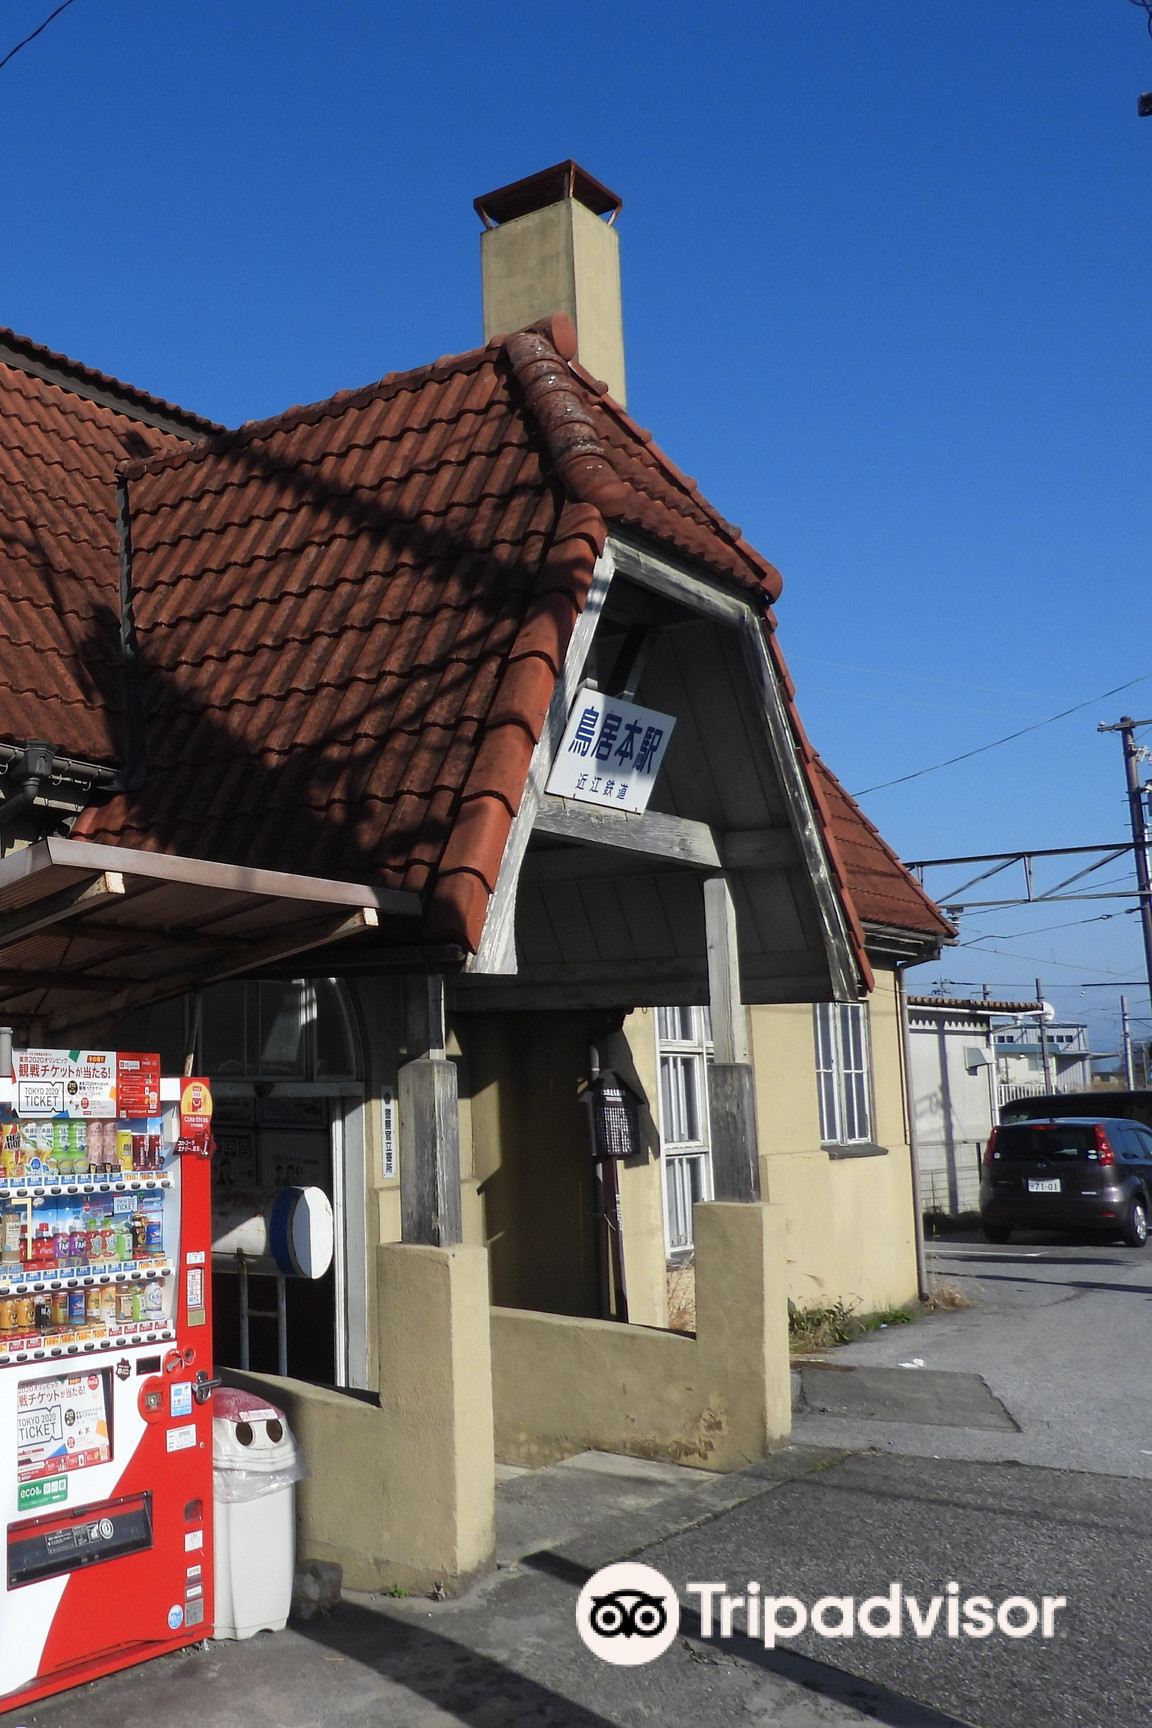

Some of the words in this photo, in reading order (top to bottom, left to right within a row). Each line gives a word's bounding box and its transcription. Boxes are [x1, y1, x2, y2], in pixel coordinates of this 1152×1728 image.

[568, 706, 663, 774] 鳥居本駅
[18, 1063, 111, 1079] 観戦チケットが当たる!
[25, 1087, 45, 1096] TOKYO
[45, 1087, 59, 1096] 2020
[25, 1096, 58, 1107] TICKET
[1035, 1182, 1058, 1191] 71-01
[18, 1416, 40, 1427] TOKYO
[41, 1413, 57, 1424] 2020
[19, 1422, 57, 1441] TICKET
